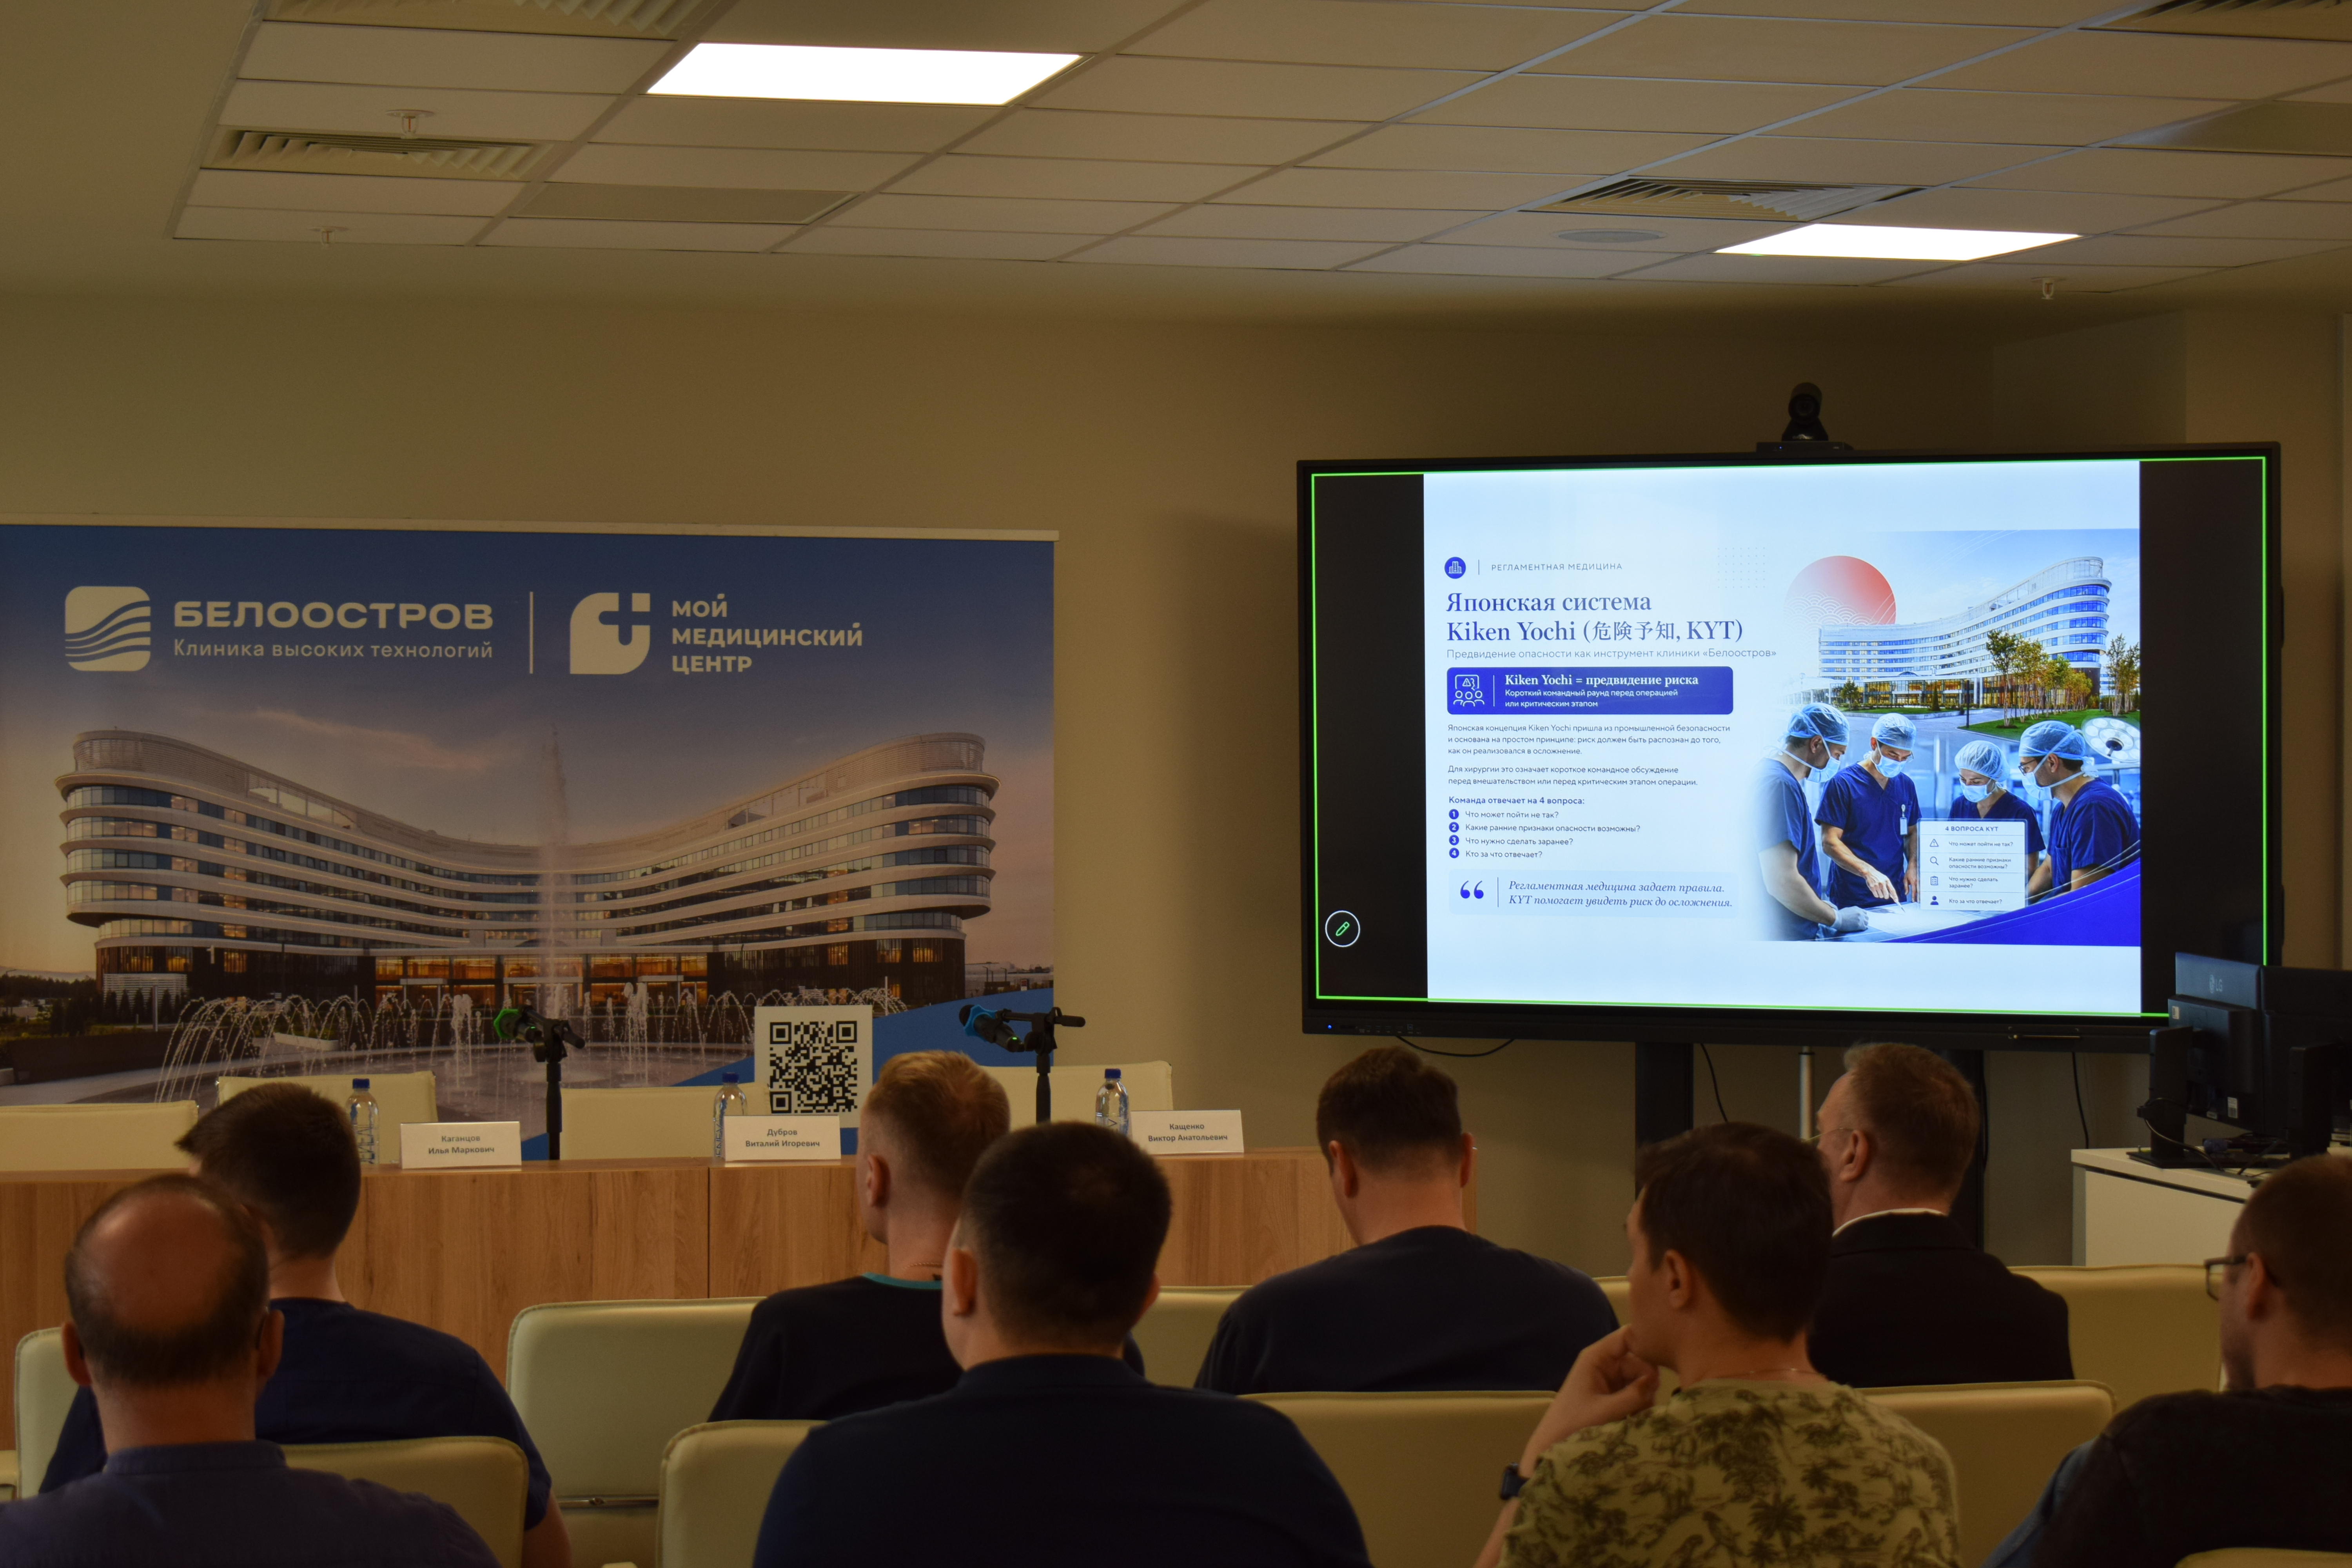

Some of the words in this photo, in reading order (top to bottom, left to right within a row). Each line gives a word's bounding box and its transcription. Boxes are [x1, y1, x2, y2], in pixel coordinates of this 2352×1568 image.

[1568, 563, 1622, 571] МЕДИЦИНА
[673, 593, 727, 617] МОЙ
[1446, 593, 1555, 612] Японская
[1563, 597, 1651, 611] система
[174, 601, 493, 630] БЕЛООСТРОВ
[673, 622, 862, 648] МЕДИЦИНСКИЙ
[1447, 621, 1510, 641] Kiken
[1517, 621, 1575, 640] Yochi
[1687, 620, 1742, 642] KYT)
[175, 639, 264, 656] Клиника
[272, 645, 364, 657] высоких
[370, 641, 492, 657] технологий
[1447, 650, 1516, 660] Предвидение
[1594, 651, 1654, 660] инструмент
[1703, 648, 1776, 659] «Белоостров»
[672, 656, 752, 675] ЦЕНТР
[1505, 674, 1538, 685] Kiken
[1541, 674, 1572, 685] Yochi
[1586, 677, 1661, 687] предвидение
[1665, 677, 1699, 687] риска
[1505, 689, 1542, 698] Короткий
[1635, 689, 1678, 698] операцией
[1614, 724, 1675, 733] промышленной
[1631, 766, 1679, 775] обсуждение
[1449, 796, 1486, 804] Команда
[1538, 838, 1573, 846] заранее?
[1509, 881, 1583, 890] Регламентная
[1586, 881, 1635, 893] медицина
[1639, 882, 1675, 891] задает
[1679, 885, 1724, 894] правила.
[1509, 895, 1533, 904] KYT
[1586, 896, 1627, 907] увидеть
[1629, 899, 1653, 908] риск
[1655, 897, 1666, 906] до
[2216, 978, 2223, 992] LG
[767, 1128, 798, 1137] Дубров
[451, 1146, 495, 1154] Маркович
[782, 1140, 820, 1148] Игоревич
